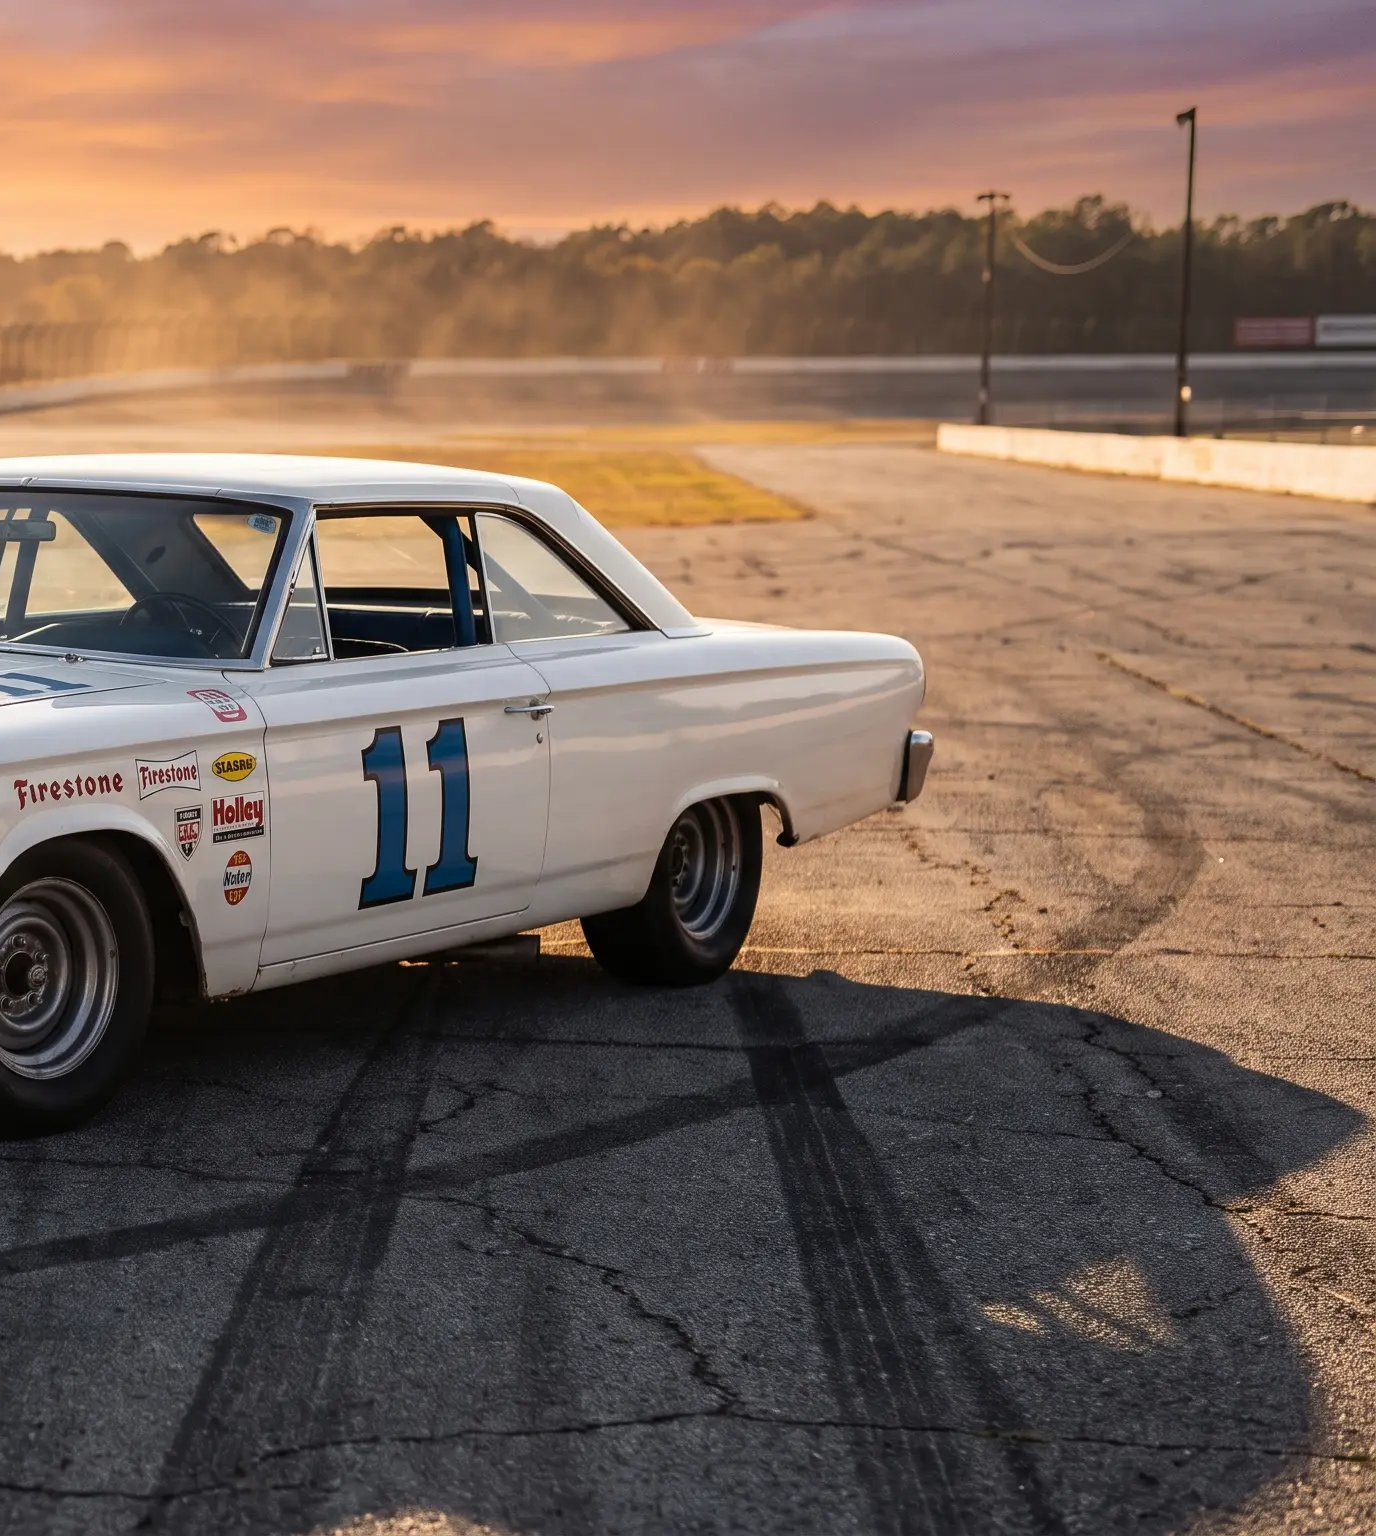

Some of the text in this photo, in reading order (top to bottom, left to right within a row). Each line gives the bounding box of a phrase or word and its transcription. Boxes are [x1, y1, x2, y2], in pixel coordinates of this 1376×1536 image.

[13, 772, 124, 811] Firestone
[139, 763, 198, 790] Firestone
[212, 796, 263, 828] Holley
[358, 717, 479, 910] 11
